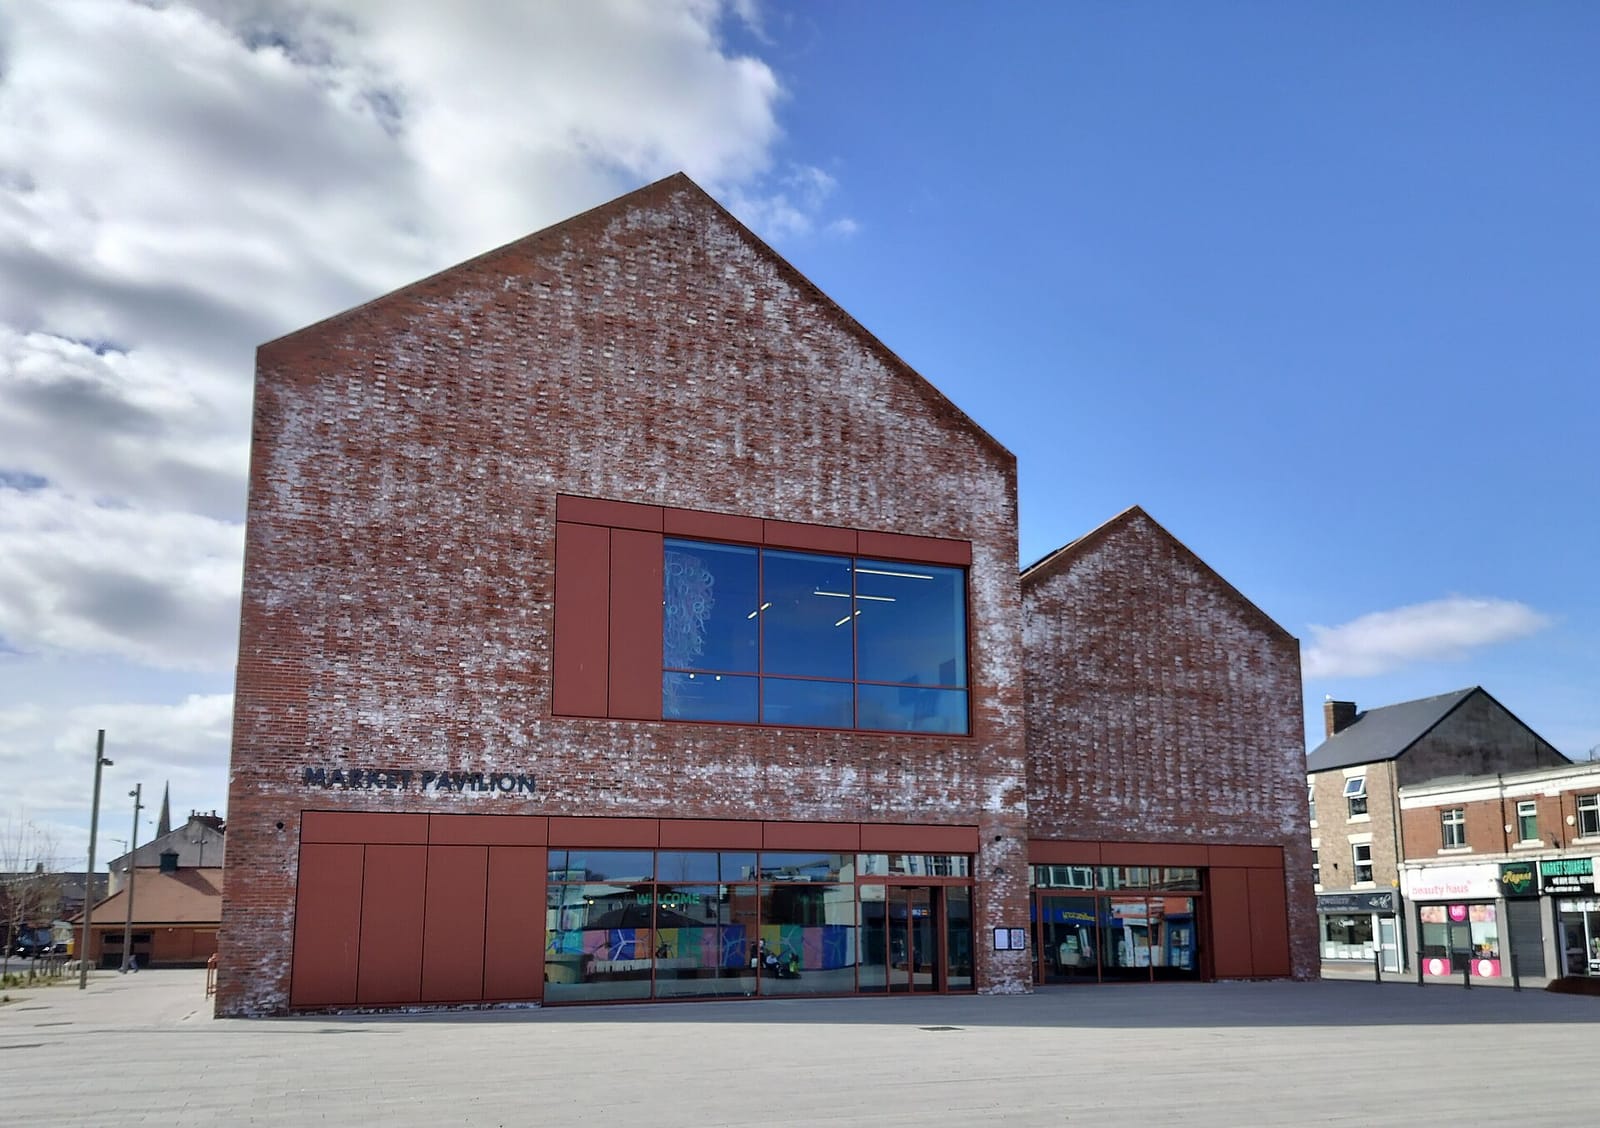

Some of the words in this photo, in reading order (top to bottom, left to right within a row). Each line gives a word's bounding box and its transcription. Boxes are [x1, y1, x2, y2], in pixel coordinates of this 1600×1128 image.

[303, 767, 415, 790] MARKET
[422, 770, 536, 793] PAVILION
[1446, 883, 1469, 894] haus
